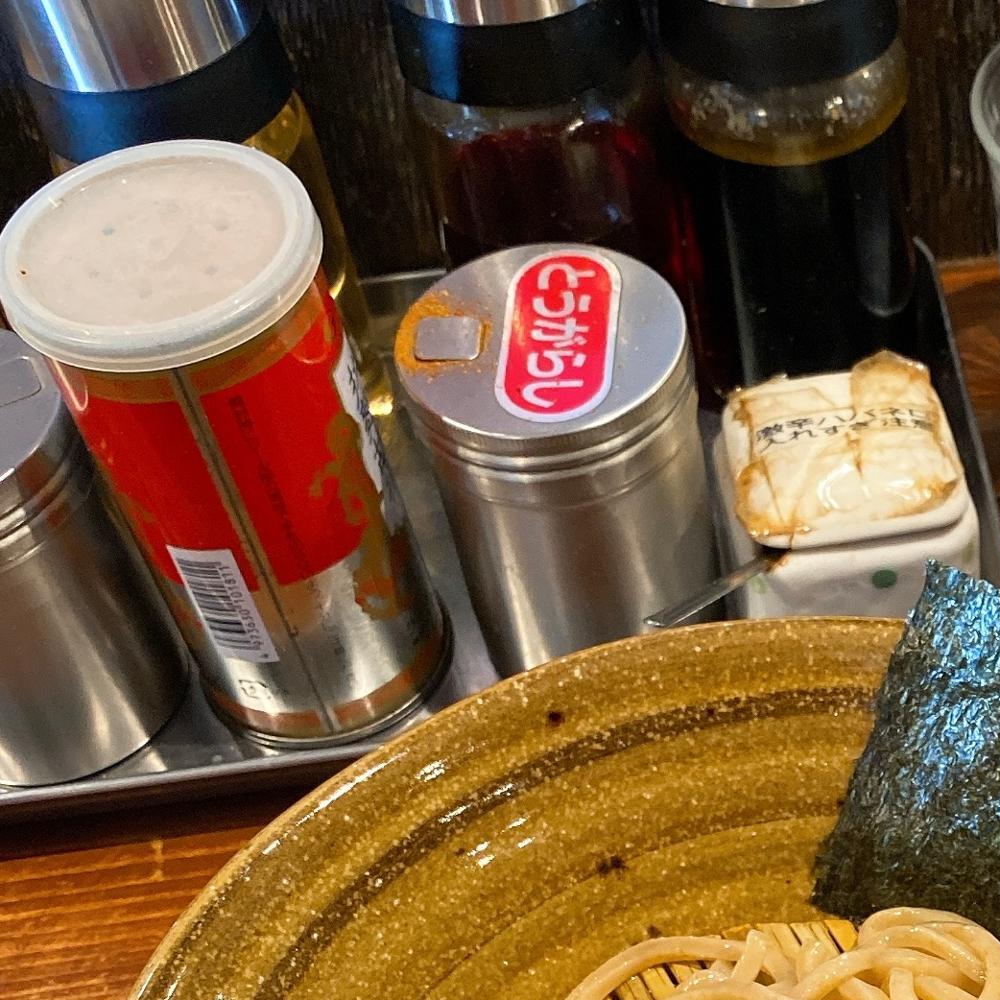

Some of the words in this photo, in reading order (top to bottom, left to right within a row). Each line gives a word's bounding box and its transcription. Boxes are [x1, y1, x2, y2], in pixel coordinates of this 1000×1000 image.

[522, 263, 596, 408] とうがらし
